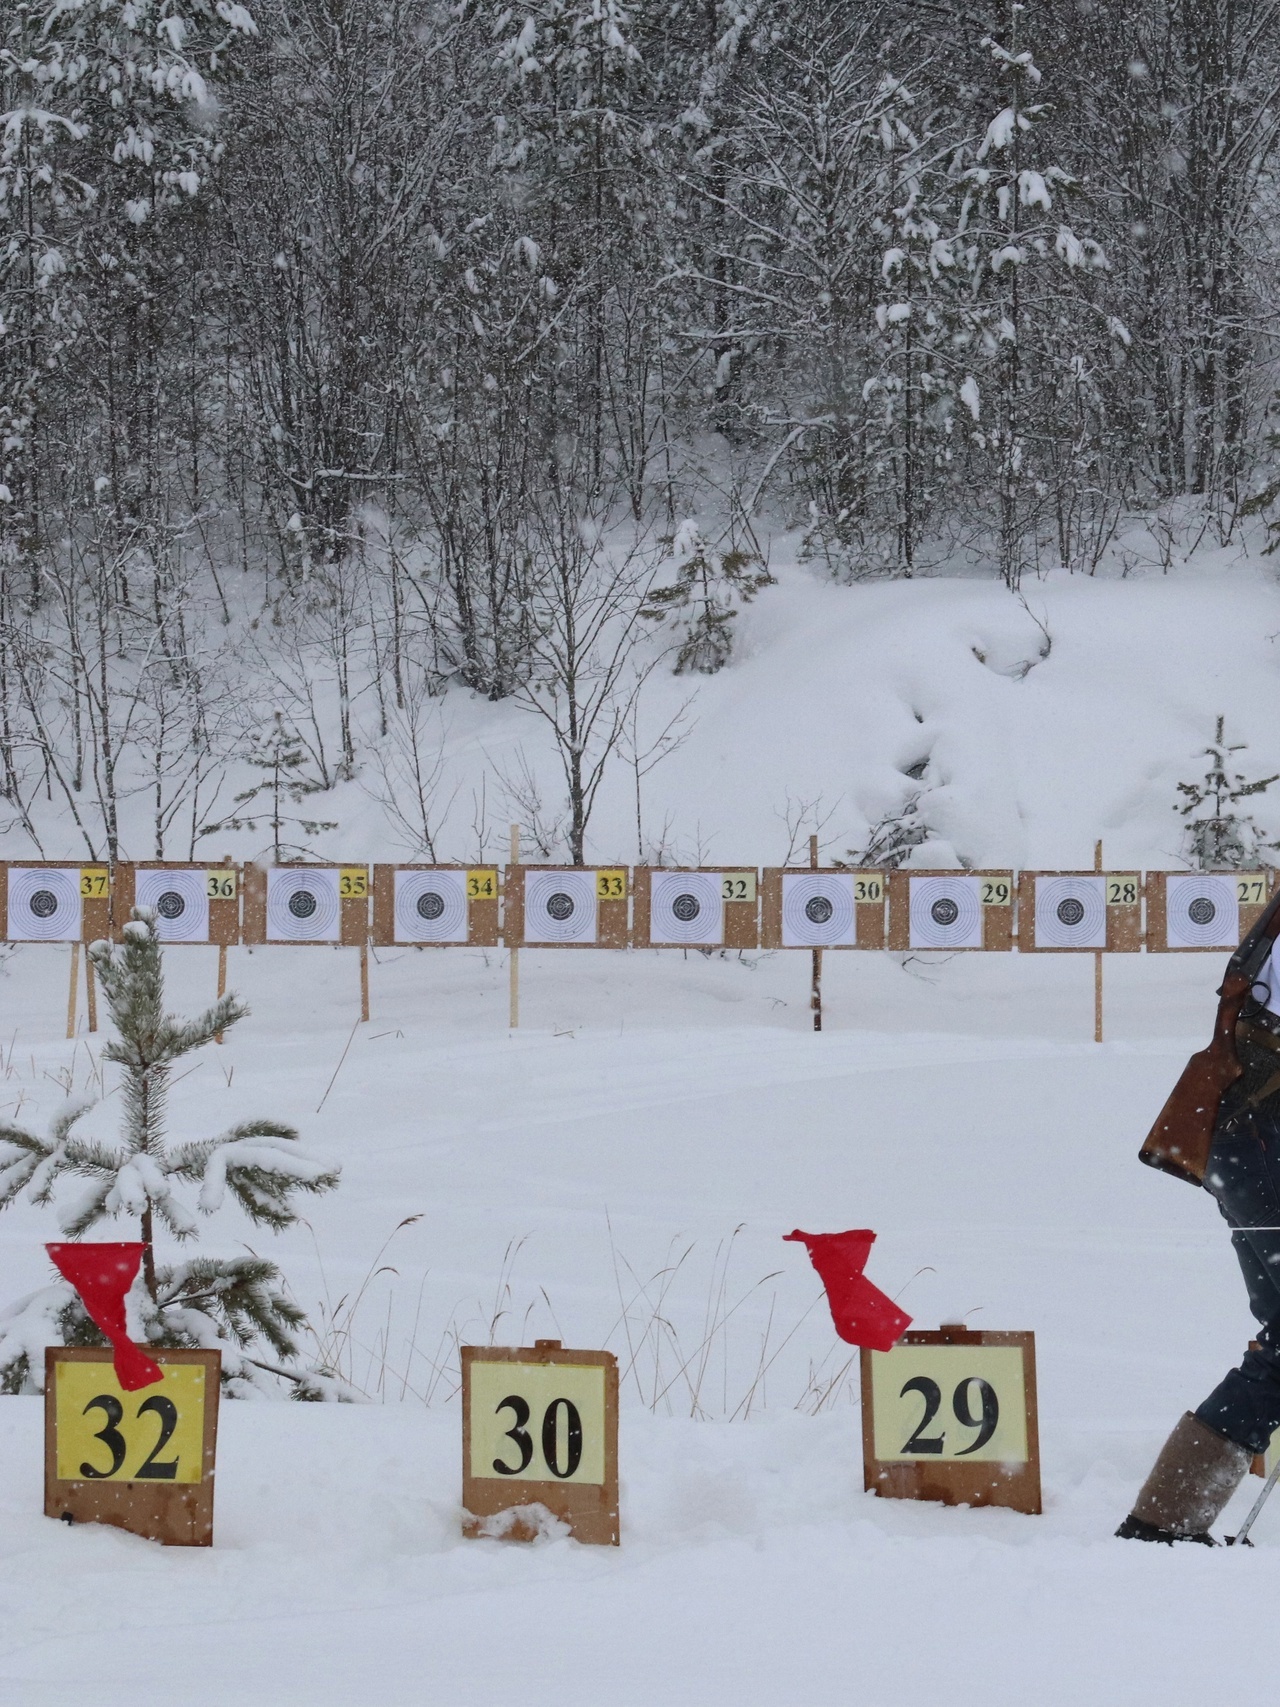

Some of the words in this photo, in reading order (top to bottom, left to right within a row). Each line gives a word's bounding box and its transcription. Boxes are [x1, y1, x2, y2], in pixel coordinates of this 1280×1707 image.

[80, 875, 107, 895] 37
[207, 877, 233, 897] 36
[340, 875, 366, 895] 35
[469, 877, 493, 896] 34
[598, 877, 623, 896] 33
[721, 879, 747, 899] 32
[856, 881, 880, 901] 30
[982, 883, 1009, 904] 29
[1109, 883, 1136, 903] 28
[1237, 882, 1264, 902] 27
[900, 1376, 999, 1455] 29
[80, 1395, 179, 1479] 32
[493, 1395, 582, 1478] 30
